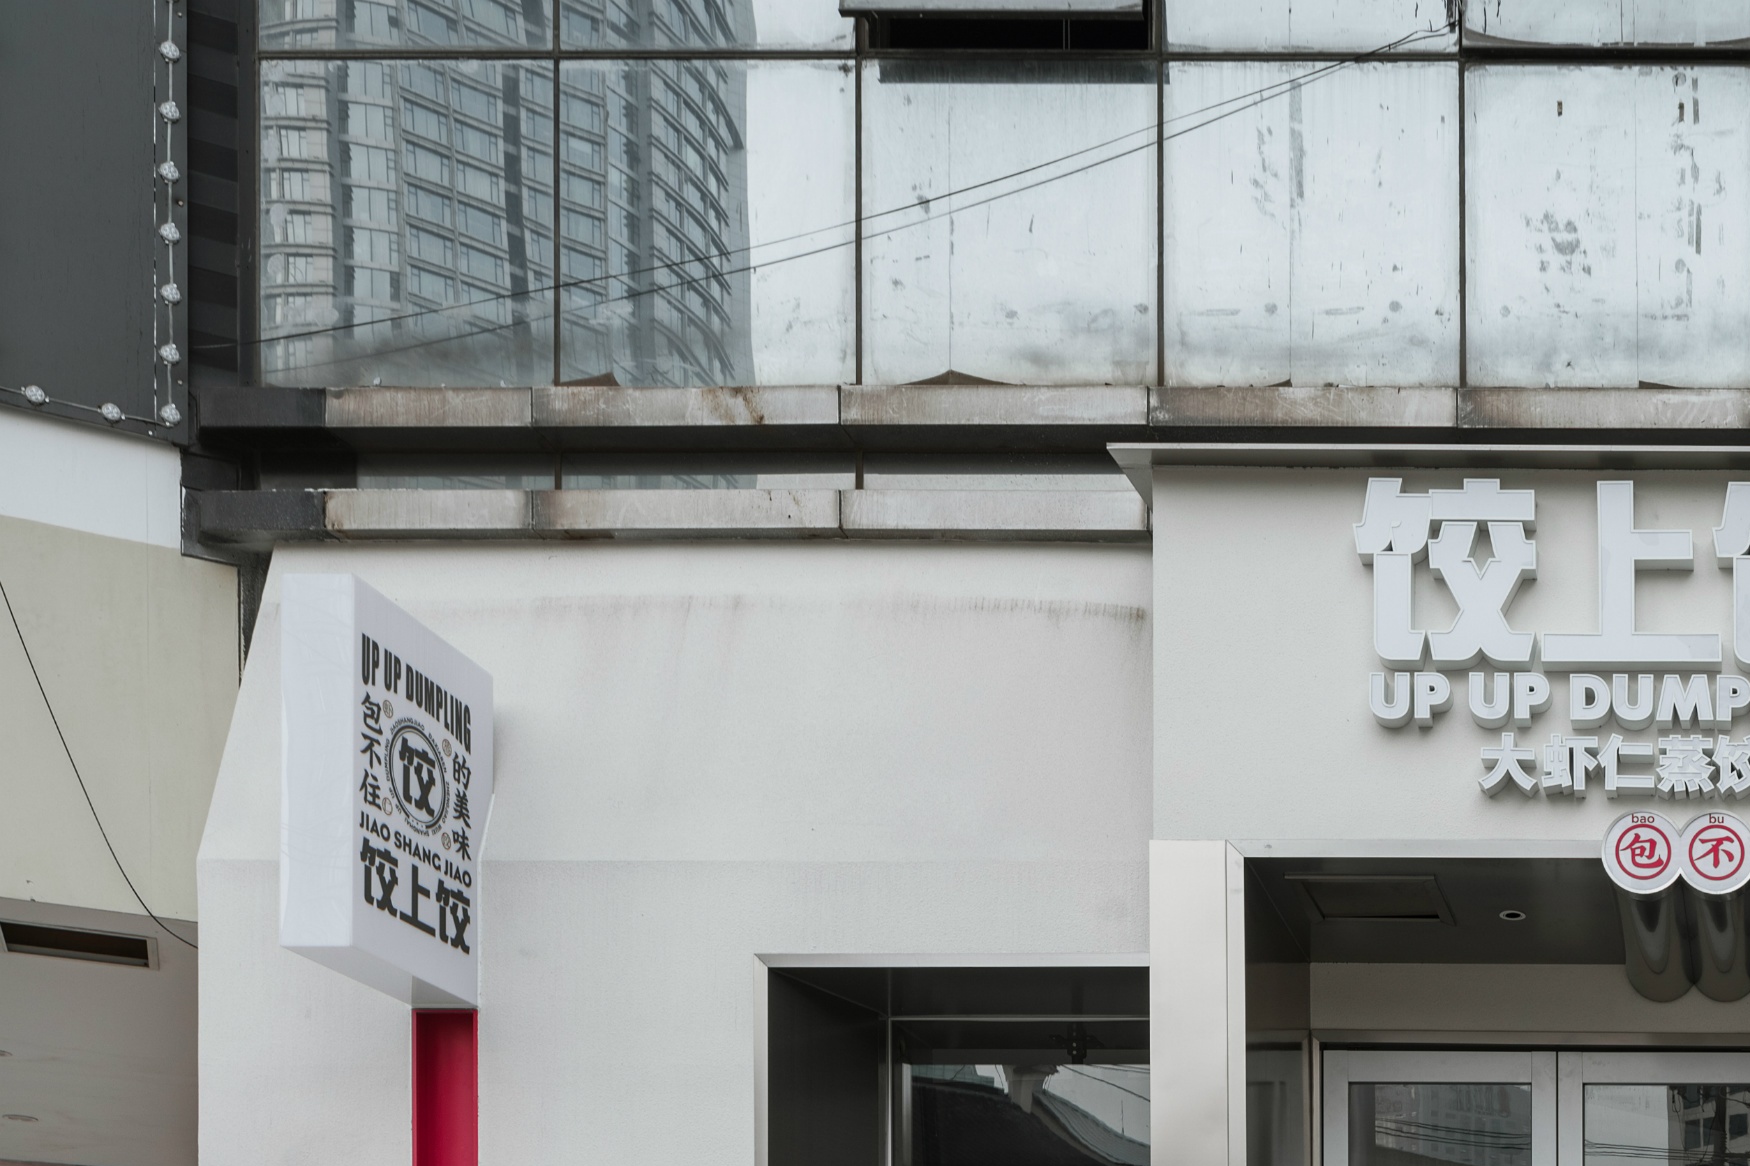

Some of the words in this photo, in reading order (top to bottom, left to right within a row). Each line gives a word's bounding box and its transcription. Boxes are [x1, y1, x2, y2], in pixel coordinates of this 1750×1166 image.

[362, 632, 380, 687] UP
[384, 647, 401, 695] UP
[406, 662, 471, 755] DUMPLING
[1369, 672, 1452, 728] UP
[1468, 672, 1552, 728] UP
[359, 691, 383, 811] 包不住
[399, 735, 436, 818] 饺
[359, 811, 391, 842] JIAO
[394, 830, 441, 872] SHANG
[444, 859, 472, 888] JIAO
[452, 751, 472, 861] 的美味
[1631, 813, 1655, 824] bao
[1709, 814, 1724, 824] bu
[359, 836, 471, 955] 饺上饺
